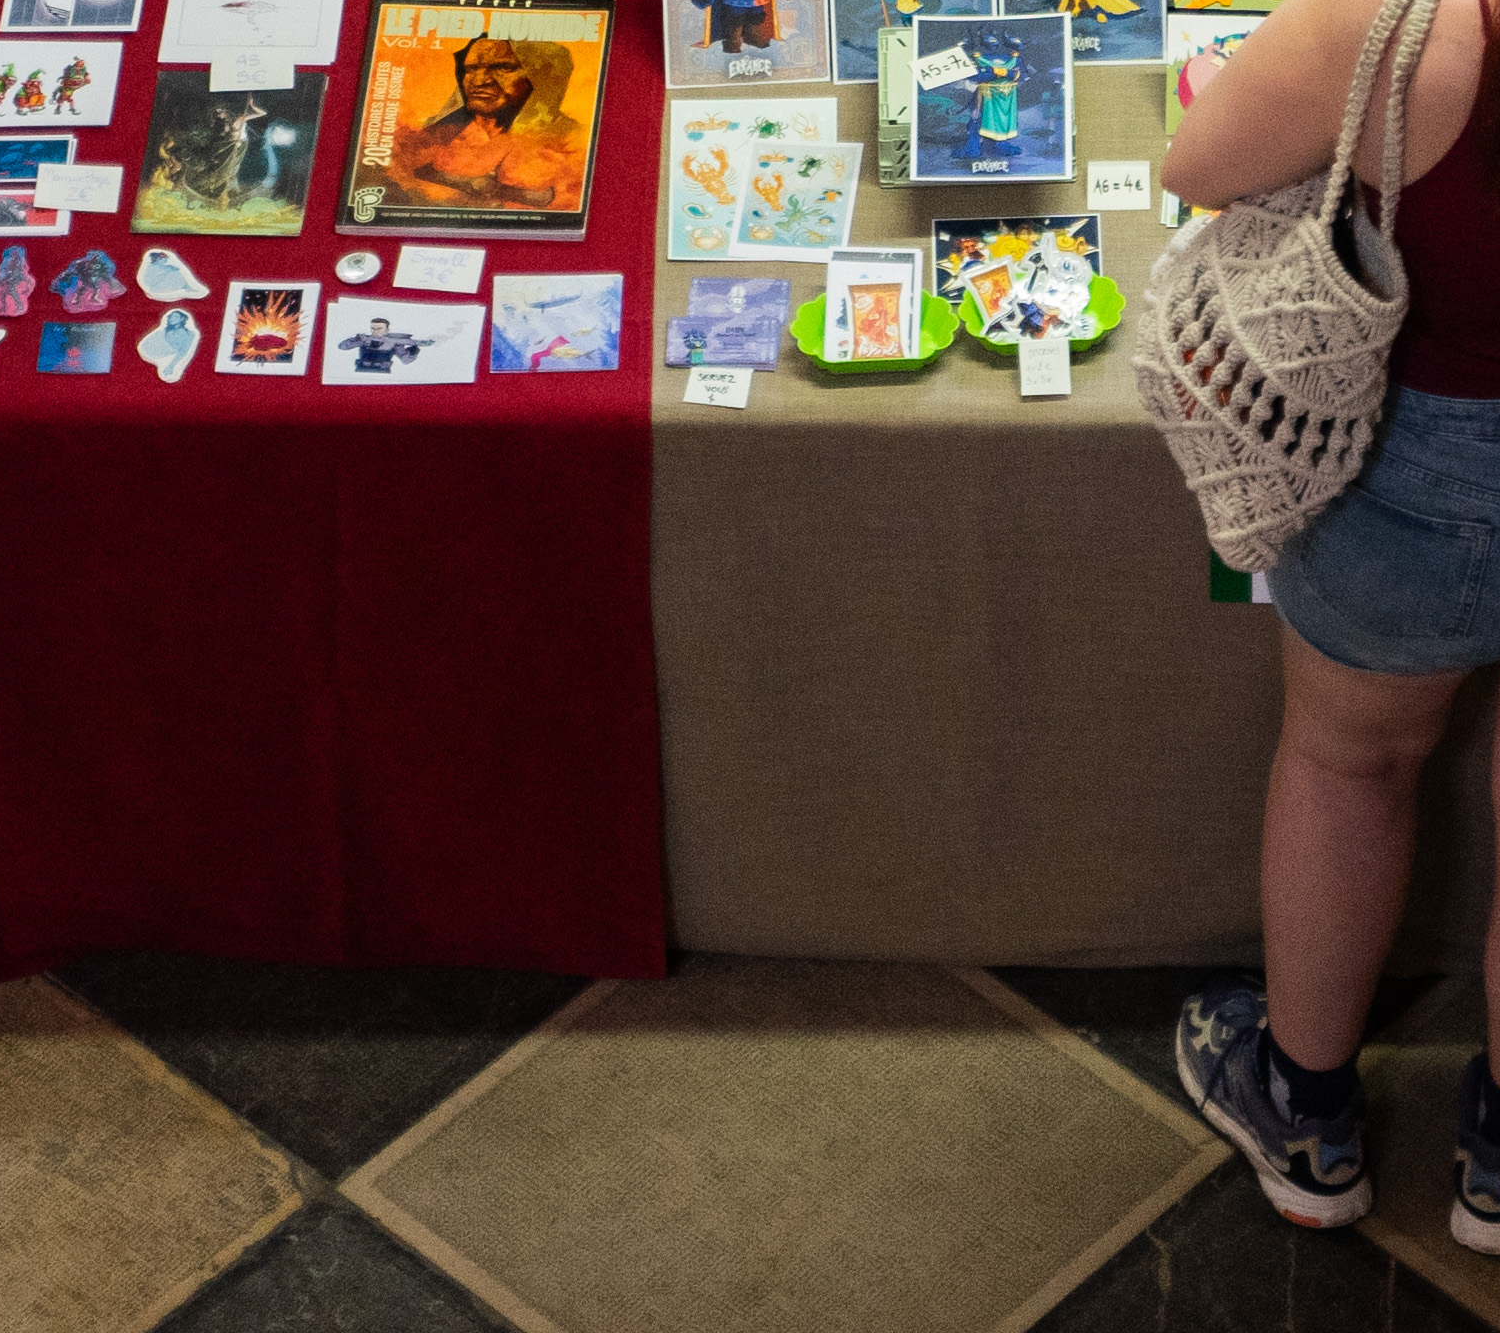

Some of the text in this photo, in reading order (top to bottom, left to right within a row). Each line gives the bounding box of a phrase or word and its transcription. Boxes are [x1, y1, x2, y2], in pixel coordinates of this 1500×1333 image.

[384, 7, 415, 37] LE
[418, 8, 485, 39] PIED
[382, 37, 444, 50] Vol. 1
[365, 102, 383, 148] HISTOIRES
[384, 99, 400, 135] BANDE
[362, 145, 391, 166] 20
